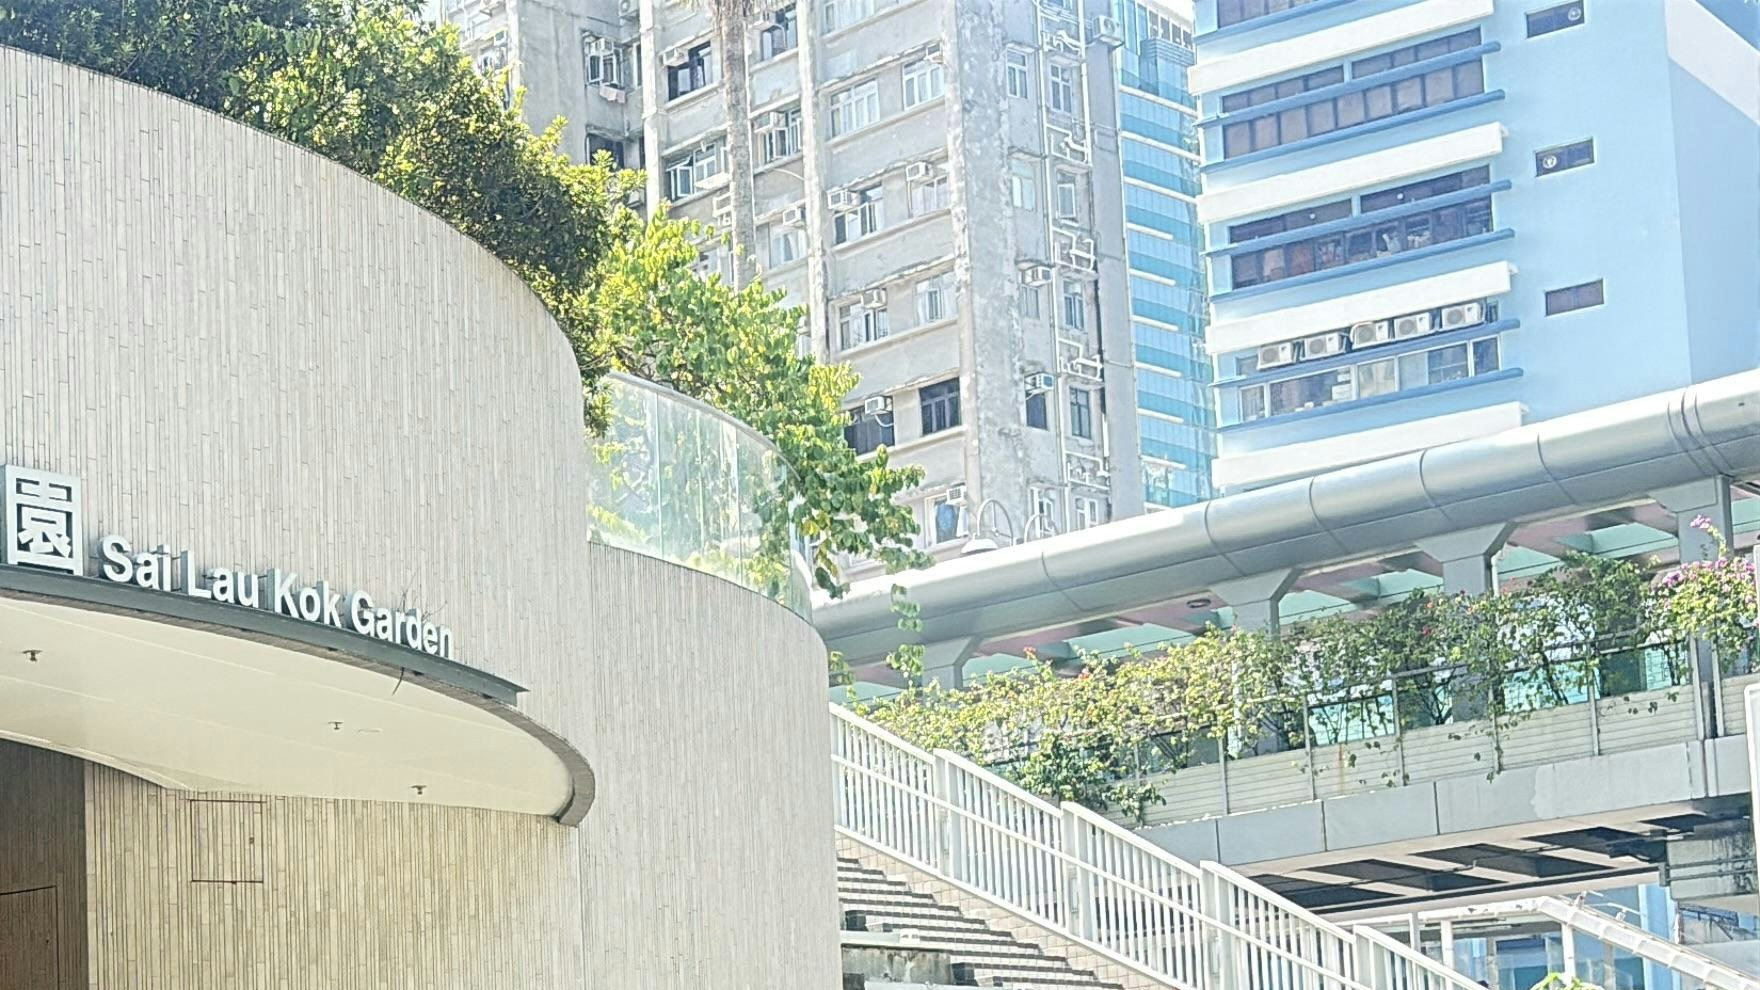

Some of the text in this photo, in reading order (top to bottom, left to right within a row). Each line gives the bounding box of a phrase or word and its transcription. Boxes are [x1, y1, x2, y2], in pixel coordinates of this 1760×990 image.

[97, 534, 456, 660] Sai Lau Kok Garden
